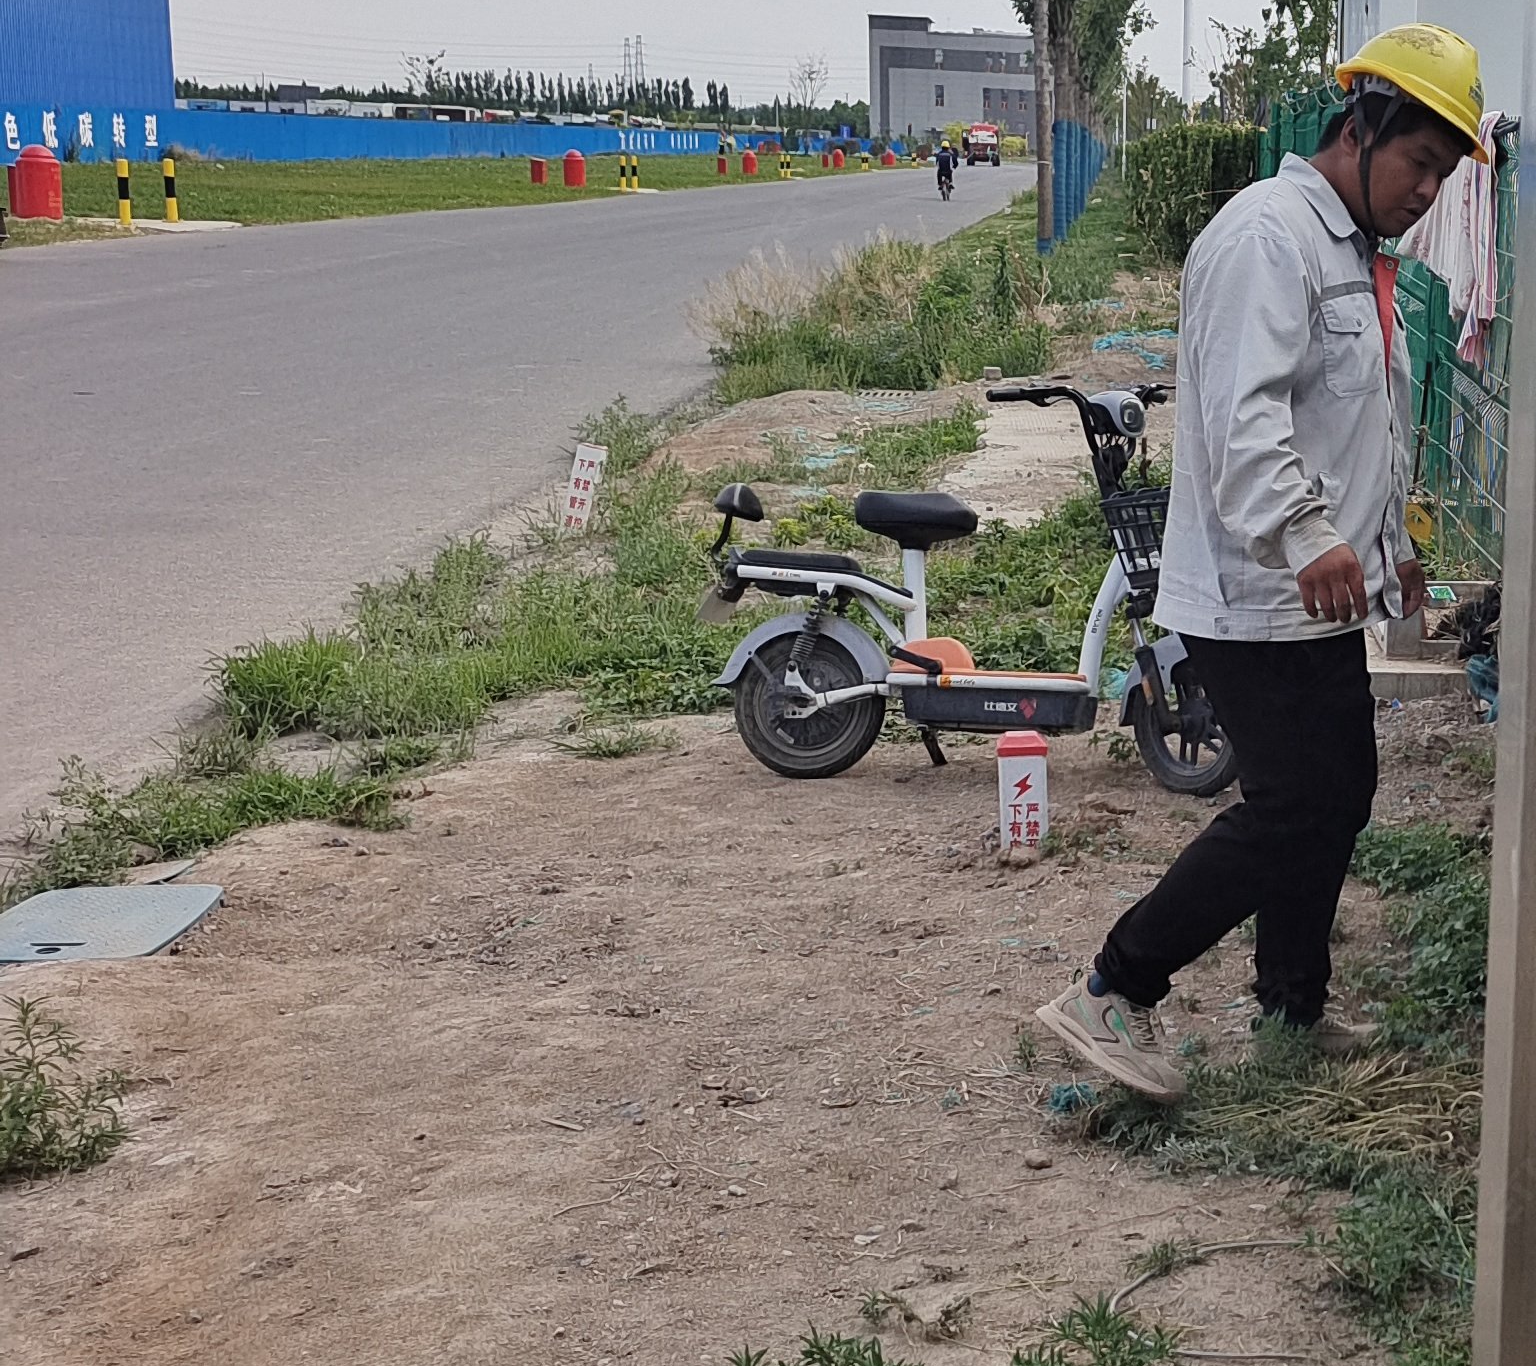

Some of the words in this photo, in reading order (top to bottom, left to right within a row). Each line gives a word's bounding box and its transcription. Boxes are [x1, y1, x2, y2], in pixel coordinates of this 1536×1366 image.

[4, 110, 159, 150] 色低碳转型
